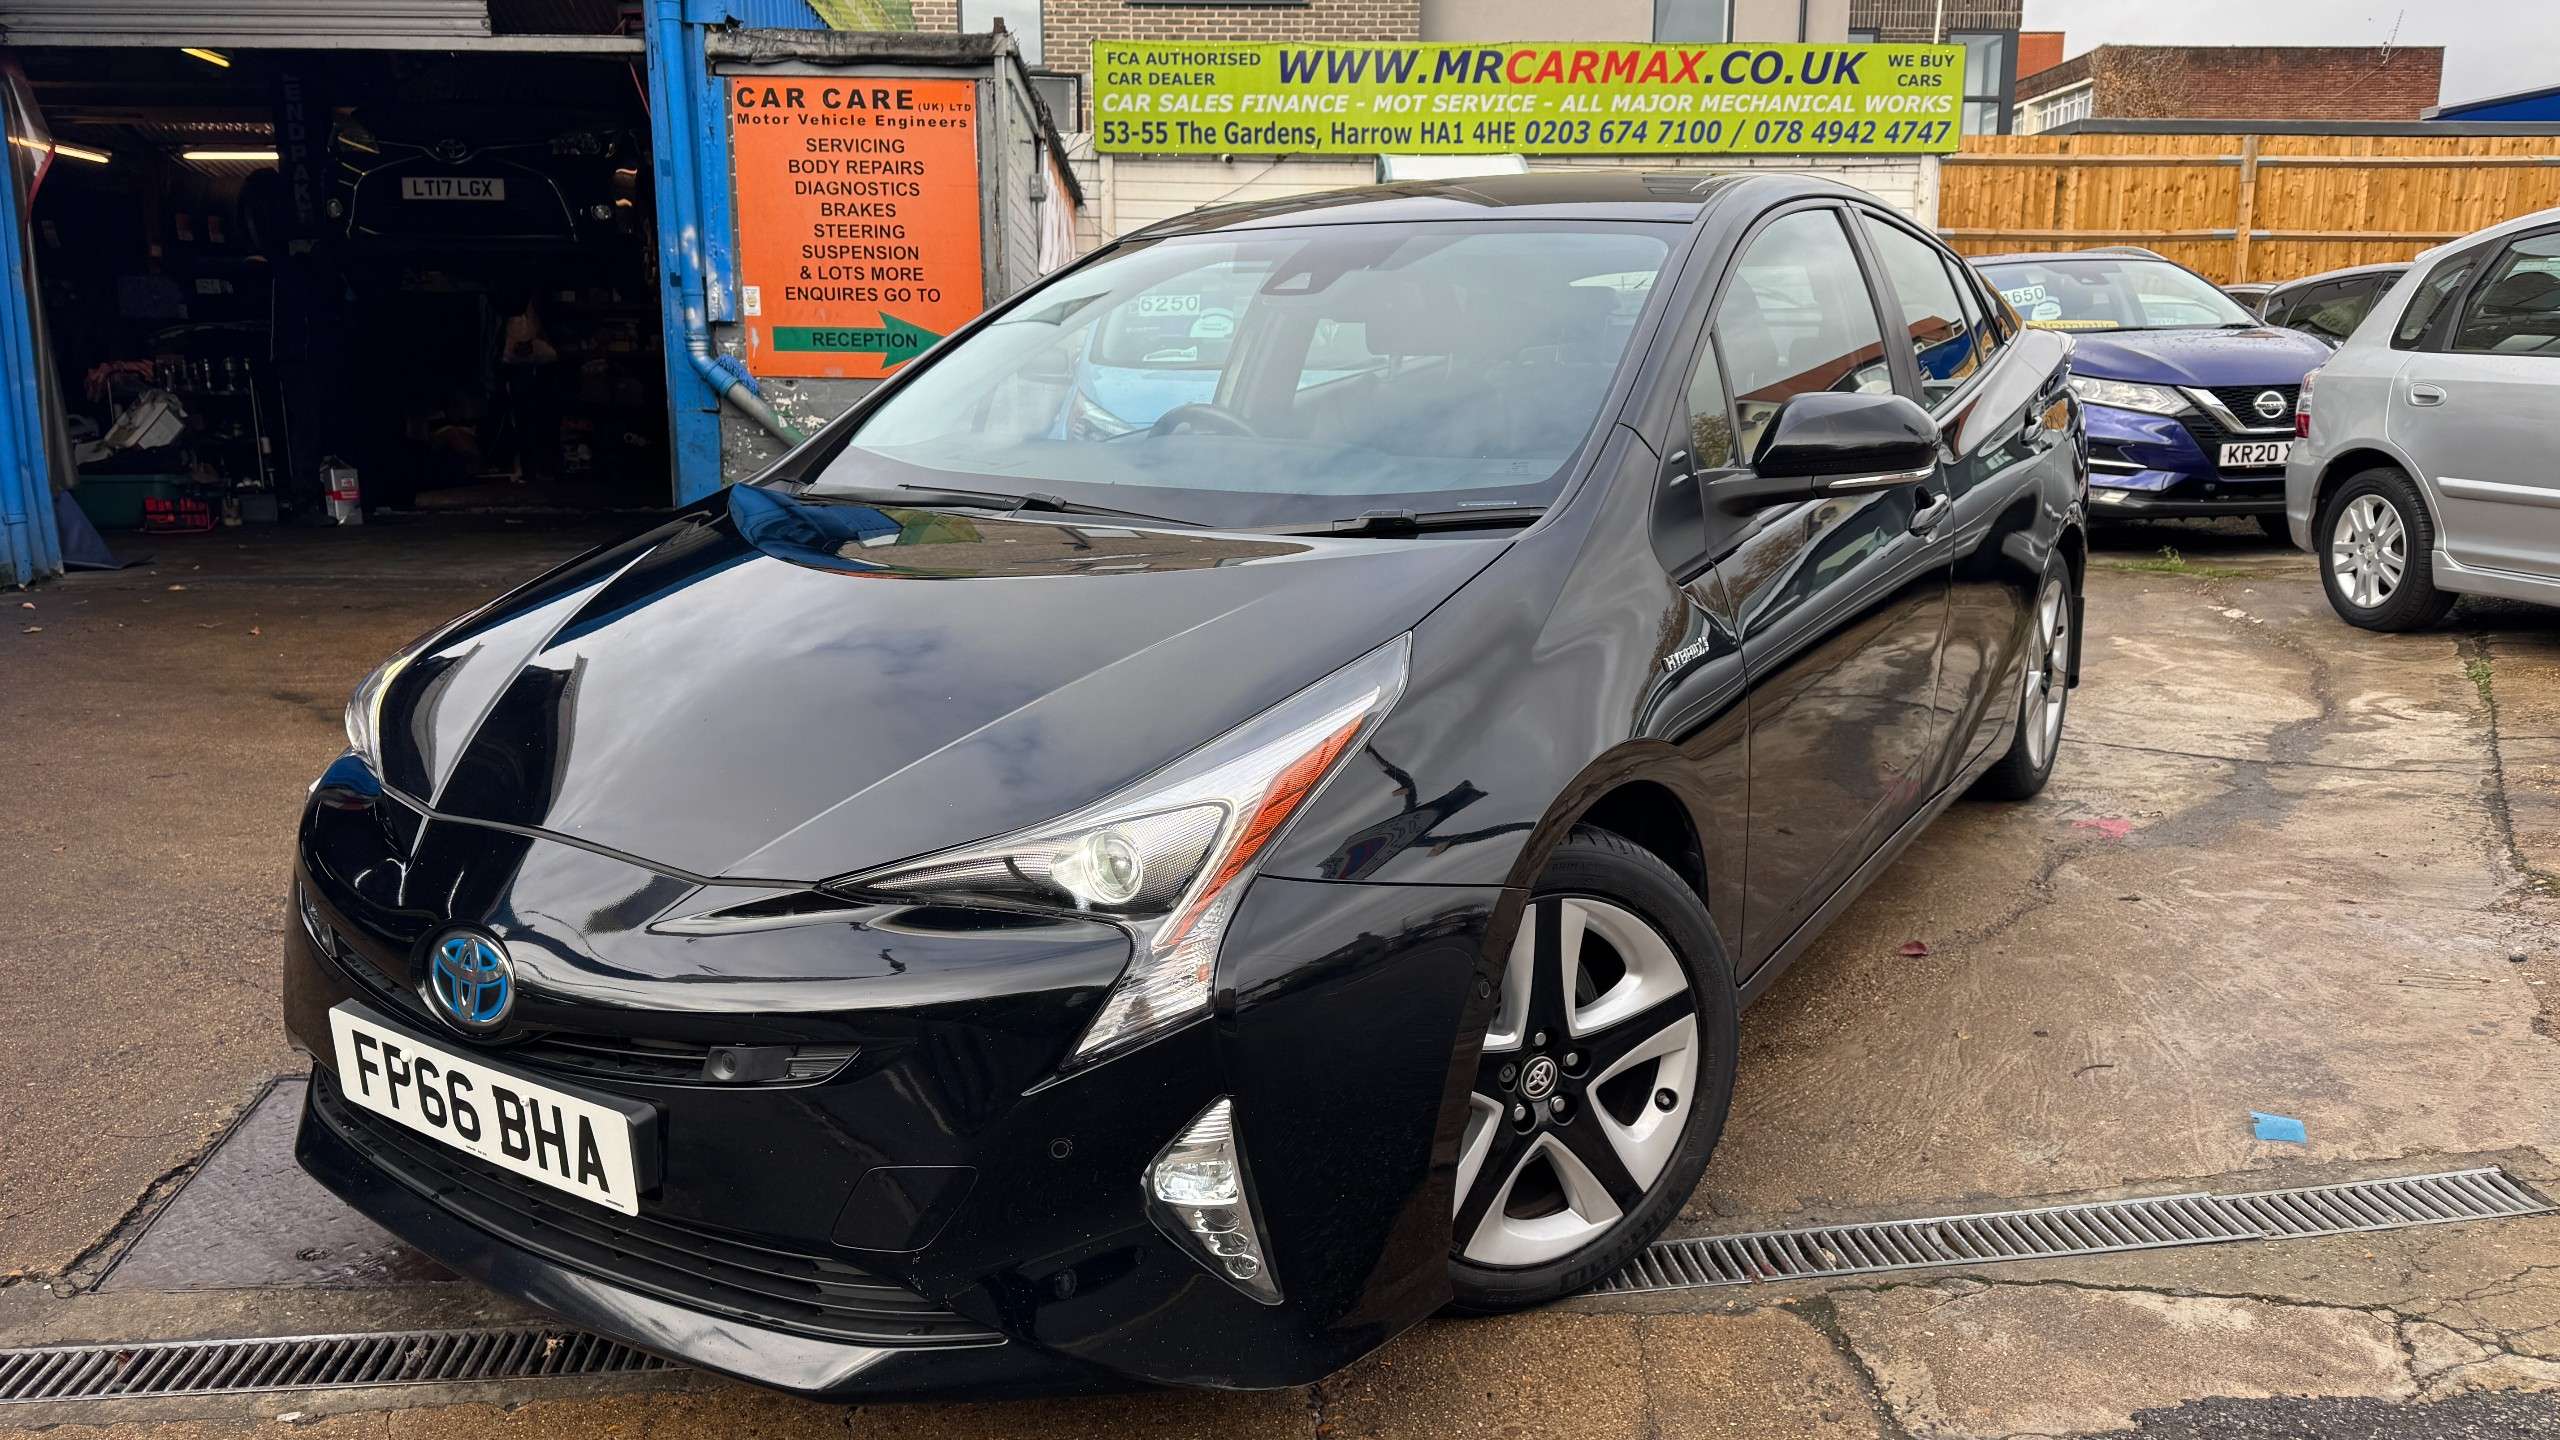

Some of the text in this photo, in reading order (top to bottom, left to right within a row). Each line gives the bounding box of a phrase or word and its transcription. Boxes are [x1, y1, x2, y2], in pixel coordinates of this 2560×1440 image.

[1107, 52, 1261, 66] FCA AUTHORISED
[1279, 49, 1867, 85] WWW.MRCARMAX.CO.UK
[1888, 55, 1955, 67] WE BUY
[1107, 72, 1216, 86] CAR DEALER
[1897, 74, 1942, 87] CARS
[736, 87, 971, 112] CAR CARE (UK) LTD
[1102, 93, 1151, 113] CAR
[1158, 93, 1234, 113] SALES
[1240, 93, 1349, 113] FINANCE
[1372, 94, 1427, 113] MOT
[1432, 94, 1537, 113] SERVICE
[1559, 94, 1603, 113] ALL
[1610, 94, 1694, 113] MAJOR
[1700, 94, 1856, 113] MECHANICAL
[1865, 94, 1953, 113] WORKS
[737, 113, 968, 129] Motor Vehicle Engineers
[1103, 119, 1953, 150] 53-55 The Gardens, Harrow HA1 4HE 0203 674 7100 / 078 4942 4747
[806, 138, 905, 153] SERVICING
[788, 159, 925, 175] BODY REPAIRS
[412, 180, 493, 197] LT17 LGX
[795, 181, 920, 197] DIAGNOSTICS
[821, 203, 897, 217] BRAKES
[814, 224, 905, 239] STEERING
[802, 245, 919, 260] SUSPENSION
[800, 266, 924, 281] & LOTS MORE
[785, 287, 941, 303] ENQUIRES GO TO
[1141, 296, 1198, 311] 6250
[812, 332, 918, 348] RECEPTION
[2227, 444, 2279, 464] KR20
[351, 1029, 610, 1193] FP66 BHA
